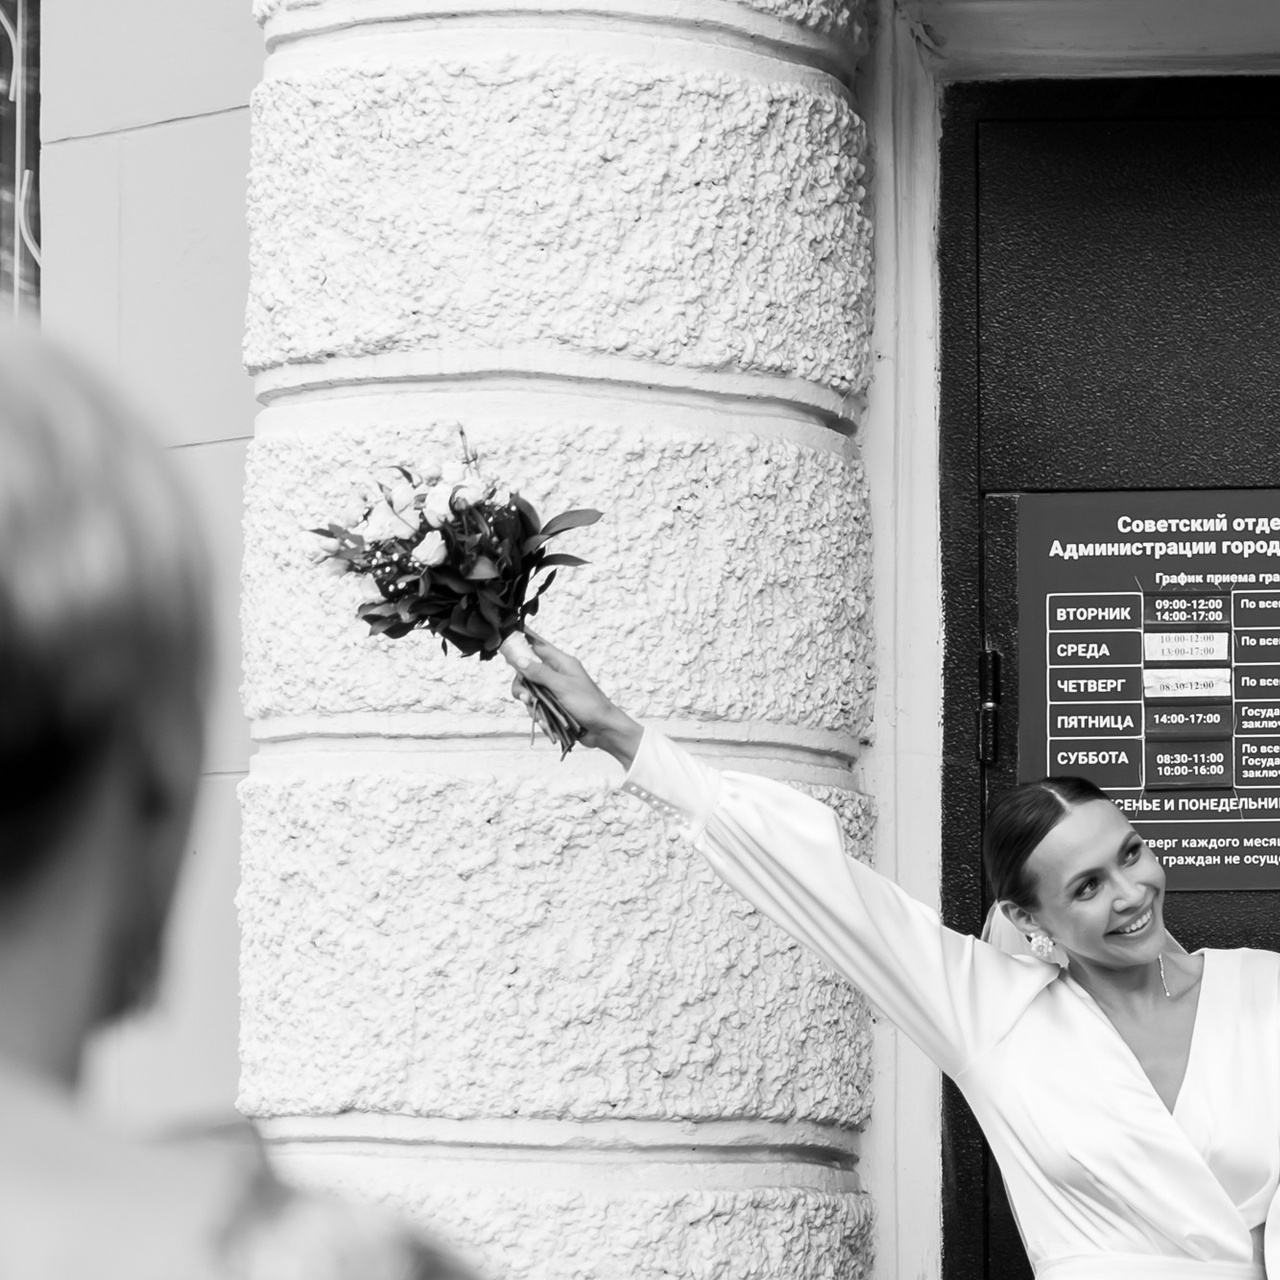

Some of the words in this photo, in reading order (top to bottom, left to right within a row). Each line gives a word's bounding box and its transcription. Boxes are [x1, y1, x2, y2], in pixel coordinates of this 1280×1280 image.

[1117, 514, 1228, 534] Советский
[1048, 540, 1217, 560] Администрации
[1155, 572, 1204, 586] График
[1206, 574, 1256, 586] приема
[1155, 599, 1223, 610] 09:00-12:00
[1240, 599, 1257, 609] По
[1056, 607, 1132, 621] ВТОРНИК
[1155, 611, 1223, 622] 14:00-17:00
[1159, 634, 1215, 643] 10:00-12:00
[1241, 636, 1257, 646] По
[1056, 644, 1111, 659] СРЕДА
[1160, 647, 1215, 657] 13:00-17:00
[1057, 679, 1127, 693] ЧЕТВЕРГ
[1241, 677, 1258, 687] По
[1057, 716, 1135, 731] ПЯТНИЦА
[1153, 714, 1221, 725] 14:00-17:00
[1241, 744, 1258, 754] По
[1056, 751, 1129, 765] СУББОТА
[1156, 753, 1225, 765] 08:30-11:00
[1157, 765, 1225, 776] 10:00-16:00
[1164, 798, 1175, 811] И
[1181, 839, 1240, 850] каждого
[1162, 856, 1221, 868] граждан
[1224, 855, 1241, 865] не
